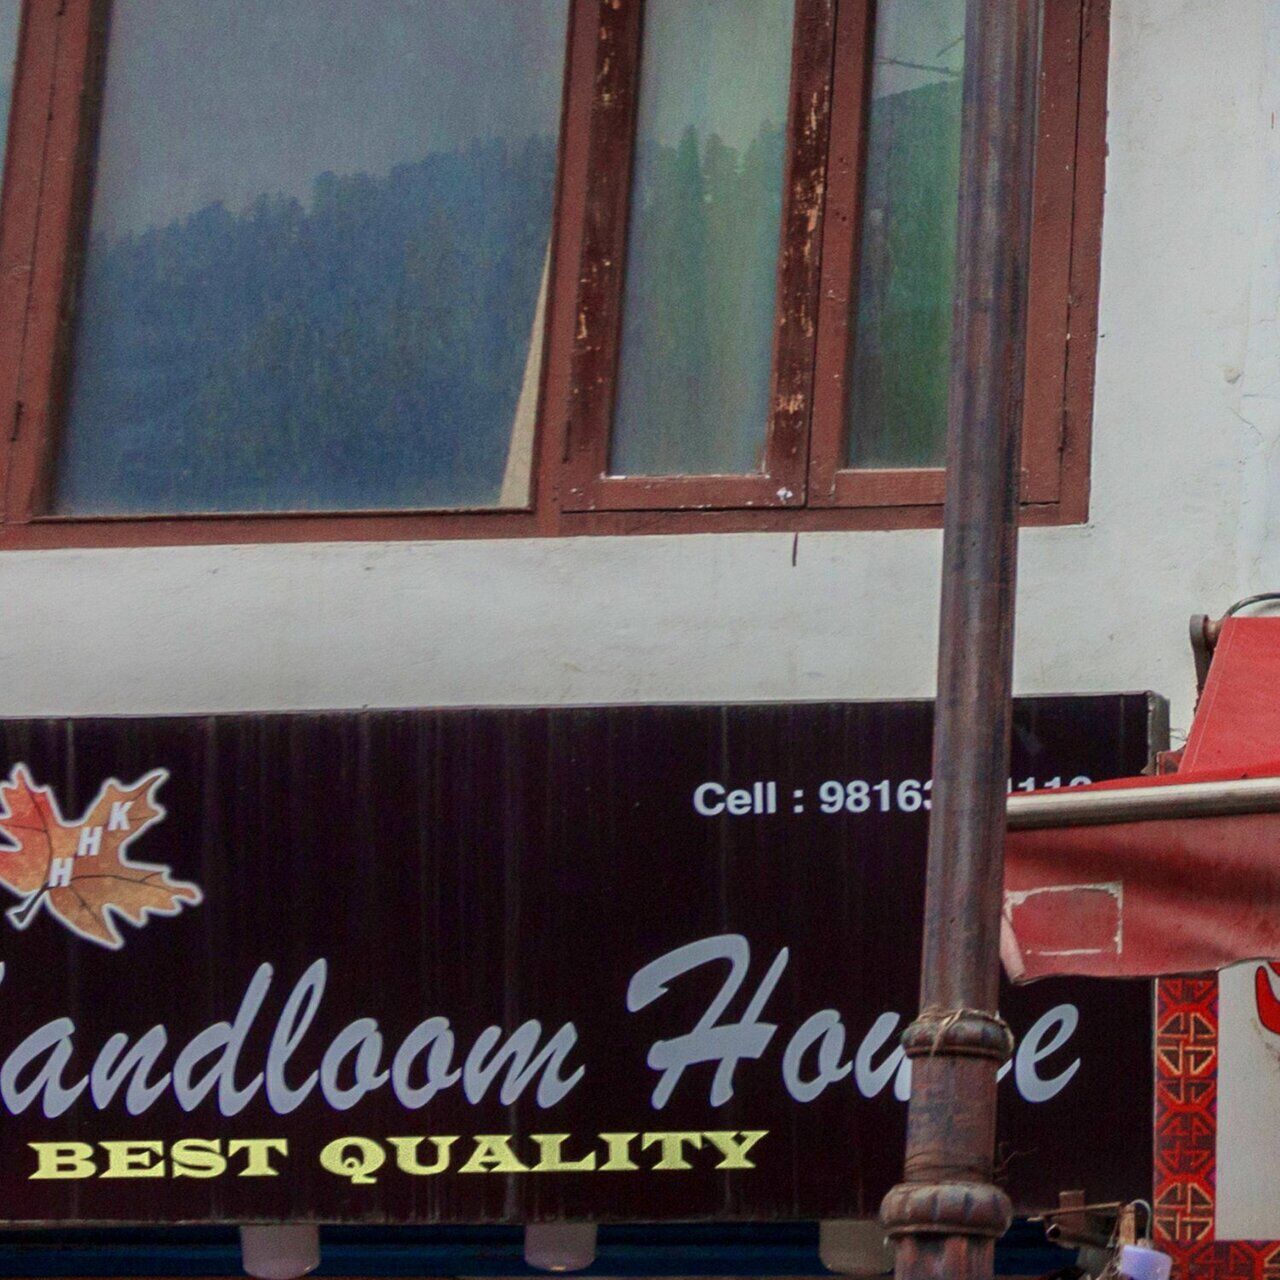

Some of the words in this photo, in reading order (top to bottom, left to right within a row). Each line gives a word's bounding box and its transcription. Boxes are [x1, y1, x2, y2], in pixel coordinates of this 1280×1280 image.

[693, 781, 777, 816] Cell
[0, 958, 585, 1118] andloom
[627, 934, 1081, 1112] Houe
[28, 1138, 289, 1180] BEST
[319, 1130, 769, 1184] QUALITY
